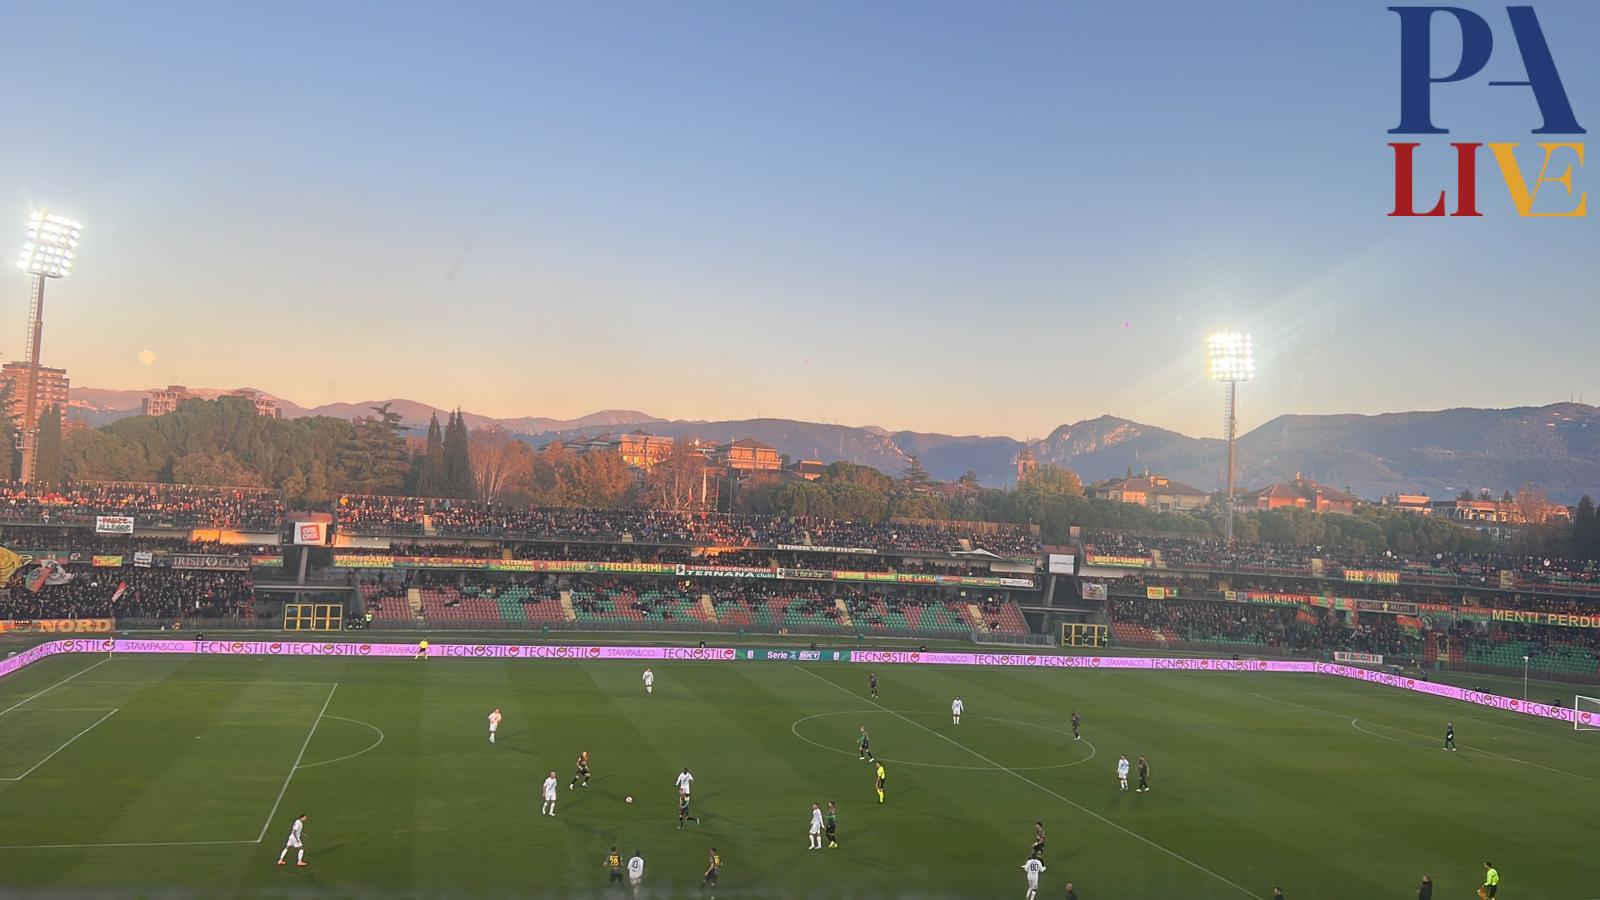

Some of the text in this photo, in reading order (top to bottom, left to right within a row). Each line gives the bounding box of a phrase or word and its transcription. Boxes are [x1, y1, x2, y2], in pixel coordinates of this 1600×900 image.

[219, 557, 248, 566] CLAN
[605, 563, 662, 572] FEDELISSIMI
[1346, 571, 1398, 584] FERE NARNI
[1492, 610, 1538, 623] MENTI
[39, 620, 111, 632] NORD
[125, 643, 184, 651] STAMPA&CO
[193, 641, 282, 654] TECNOSTILO
[286, 642, 372, 655] TECNOSTILO
[379, 646, 431, 654] STAMPA&O
[440, 645, 518, 657] TECNOSTILO
[524, 646, 599, 657] TECNOSTILO
[607, 648, 655, 657] STAMPA&CO
[663, 647, 734, 659] TECNOSTILO
[767, 651, 788, 659] Serie
[853, 651, 919, 662] TECNOSTILO
[974, 654, 1036, 666] TECNOSTILO
[1039, 655, 1100, 667] TECNOSTILO
[1150, 658, 1208, 670] TECNOSTILO
[1211, 659, 1267, 670] TECNOSTILO
[1312, 662, 1364, 679] TECNOSTILO
[1366, 671, 1415, 689] TECNOSTILO
[1460, 689, 1518, 711] TECNOSTILO
[1030, 863, 1039, 872] 80
